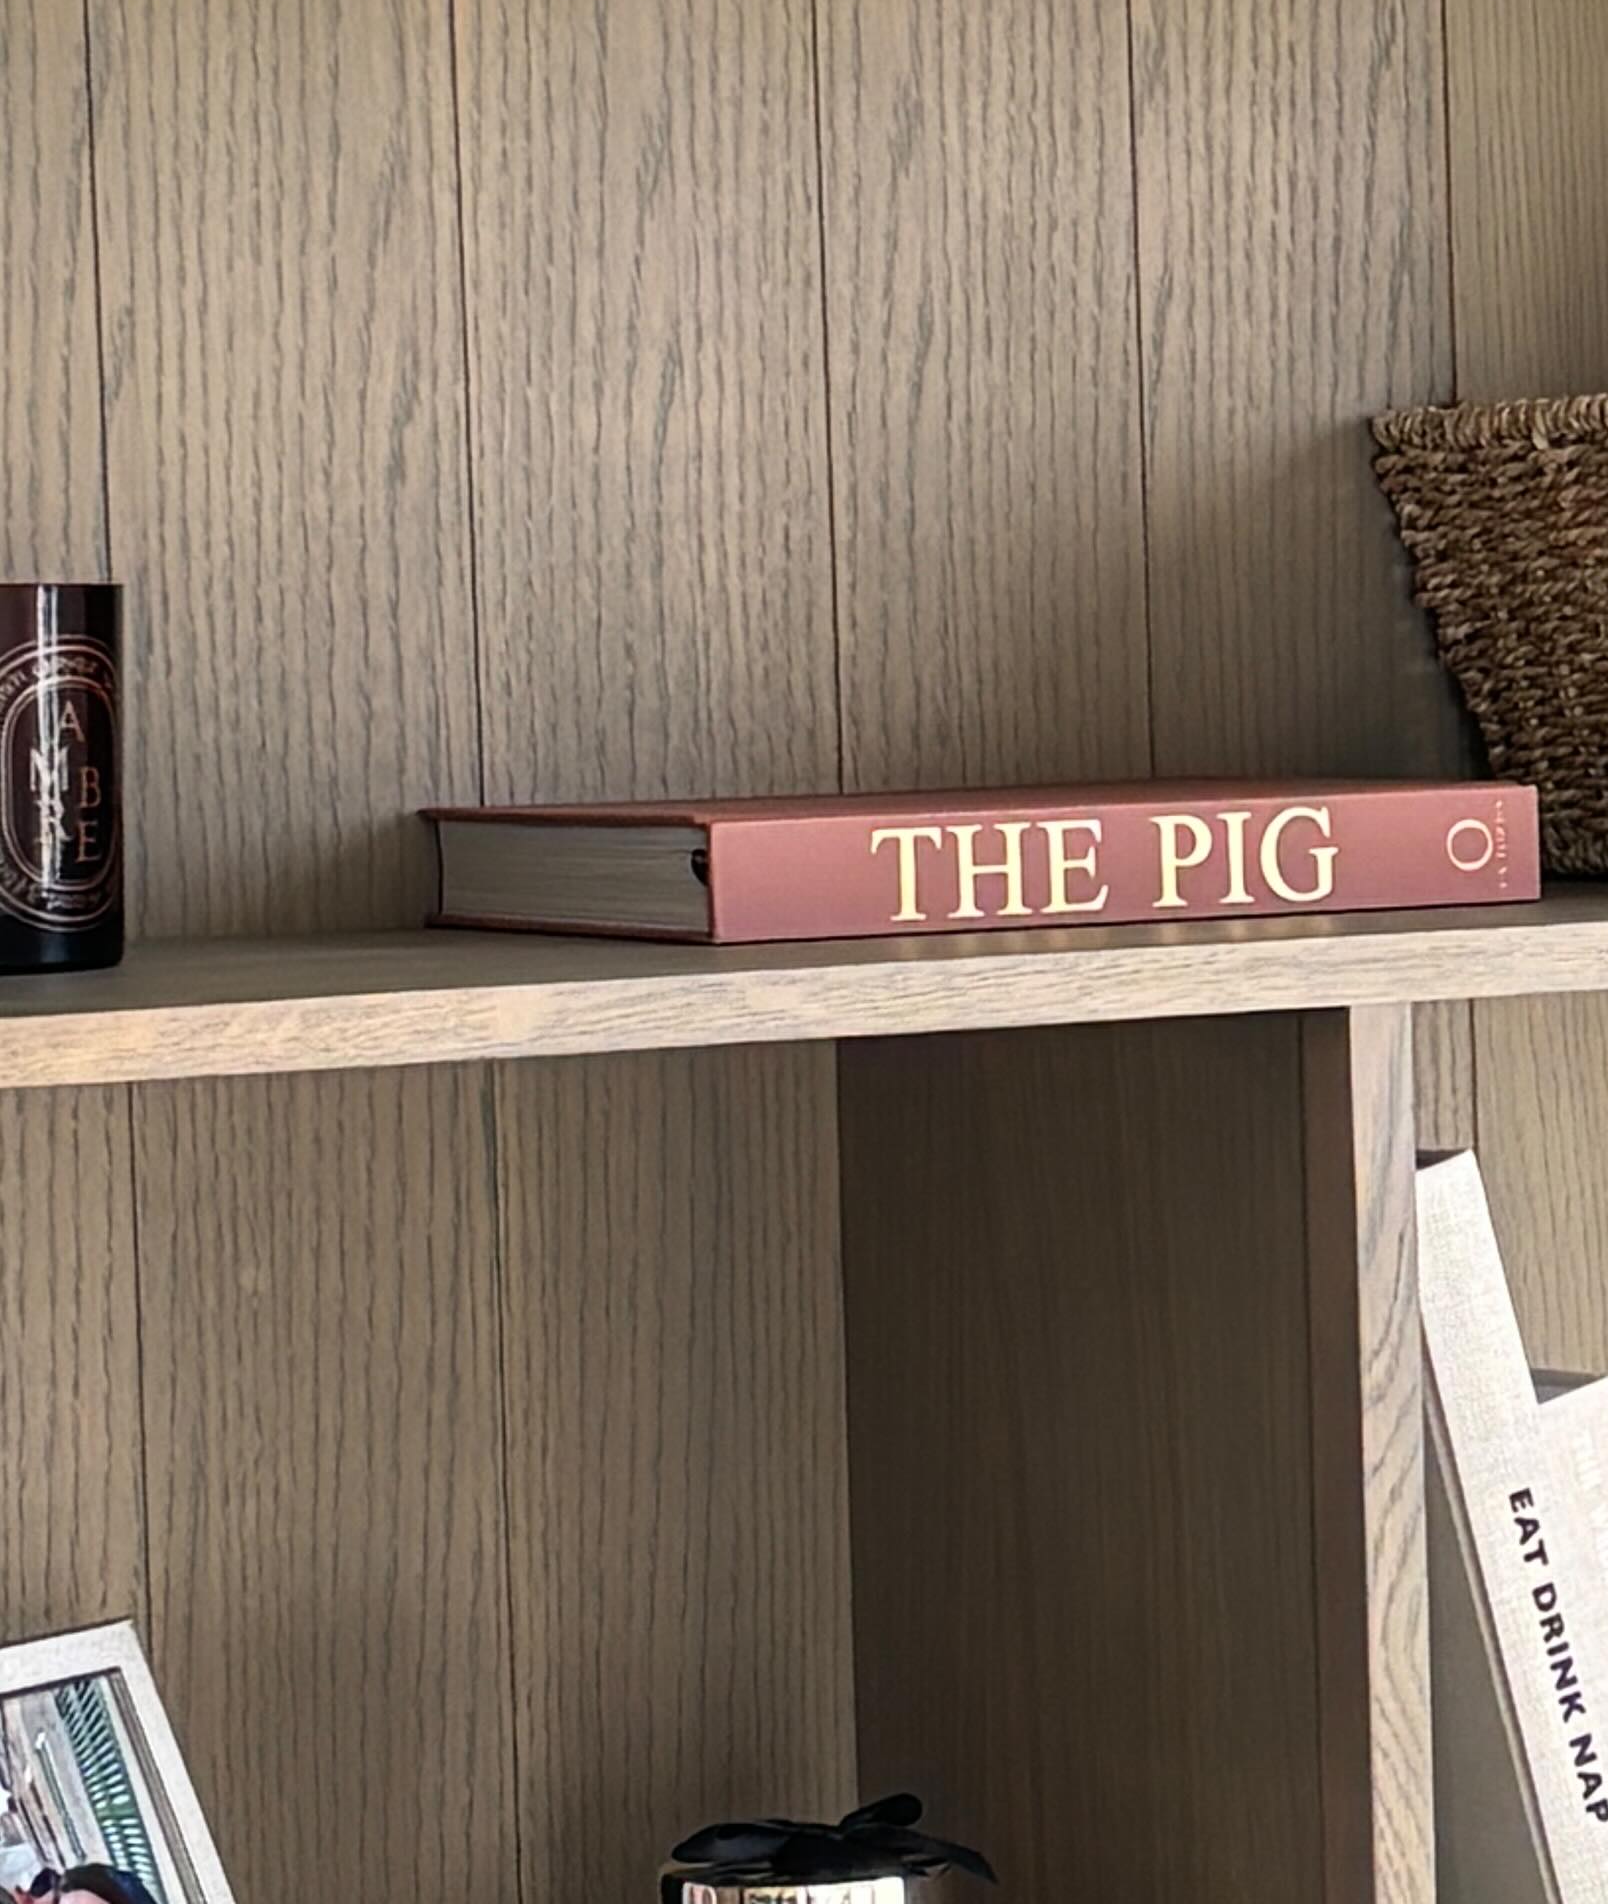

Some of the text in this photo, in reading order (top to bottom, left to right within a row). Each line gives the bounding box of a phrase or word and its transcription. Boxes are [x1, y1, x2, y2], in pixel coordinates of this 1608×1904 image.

[870, 806, 1338, 922] THE PIG
[1509, 1488, 1548, 1570] EAT
[1532, 1582, 1586, 1723] DRINK
